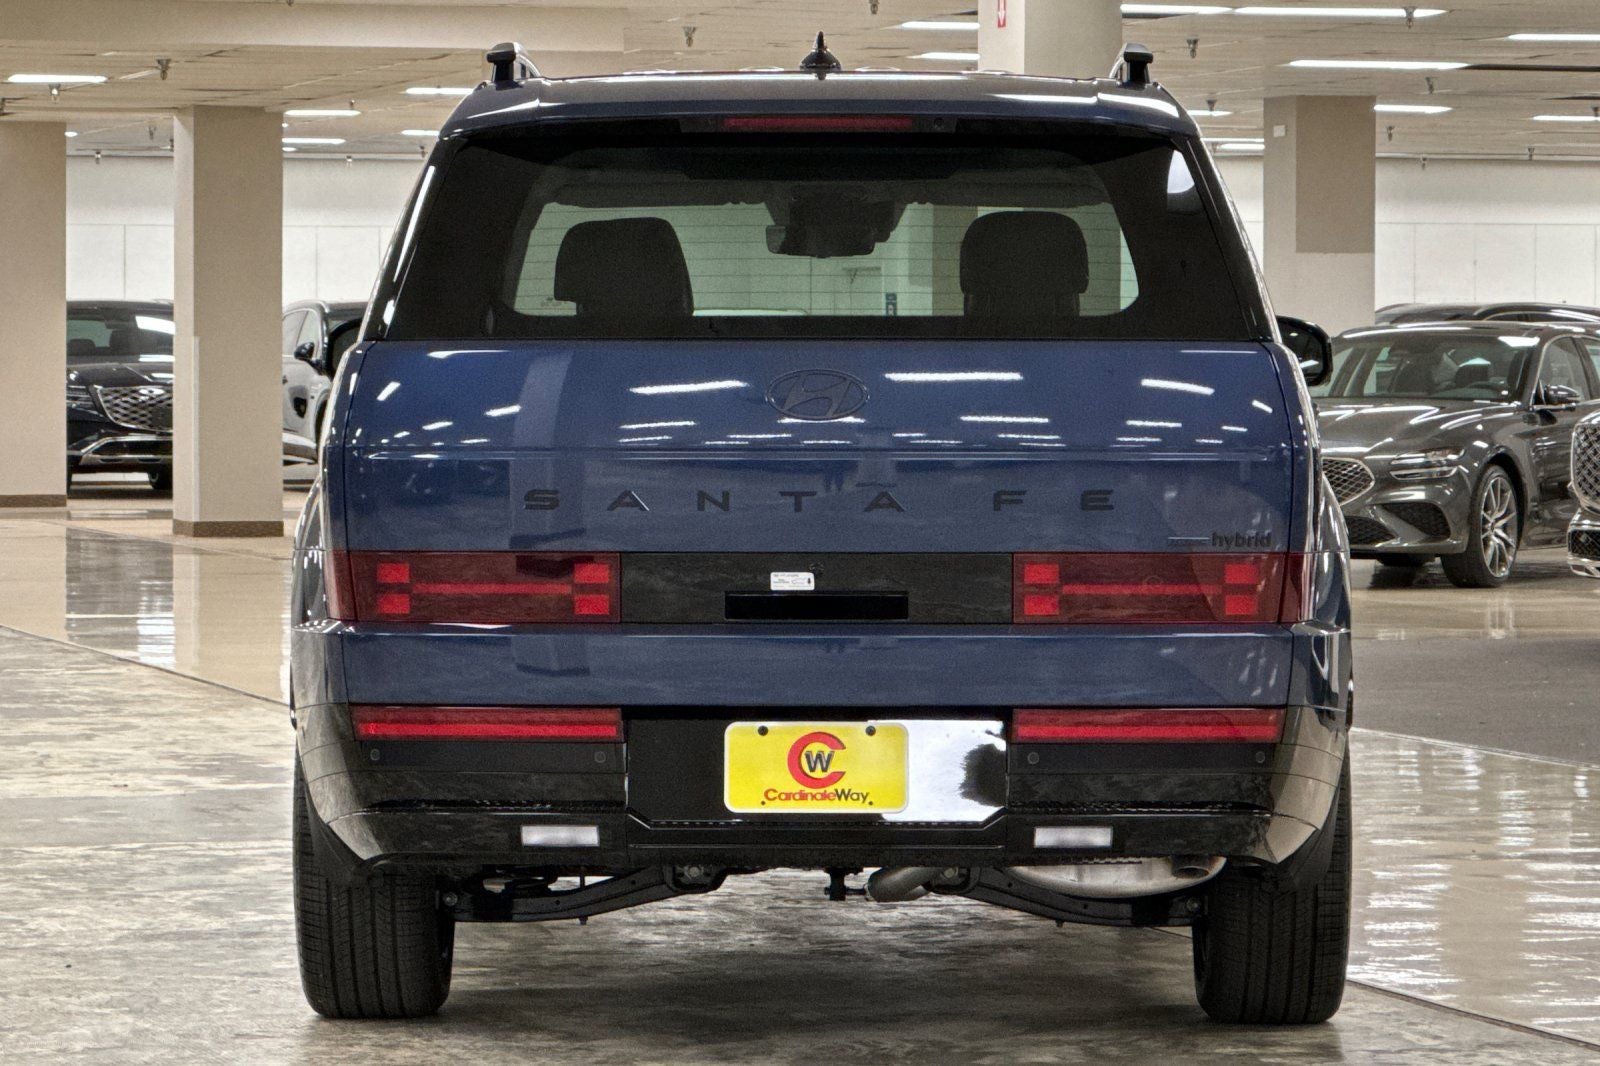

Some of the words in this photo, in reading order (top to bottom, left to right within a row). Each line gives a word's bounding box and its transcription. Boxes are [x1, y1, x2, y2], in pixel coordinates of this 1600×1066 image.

[524, 489, 904, 512] SANTA
[994, 489, 1114, 511] FE
[1211, 531, 1272, 549] hybrid
